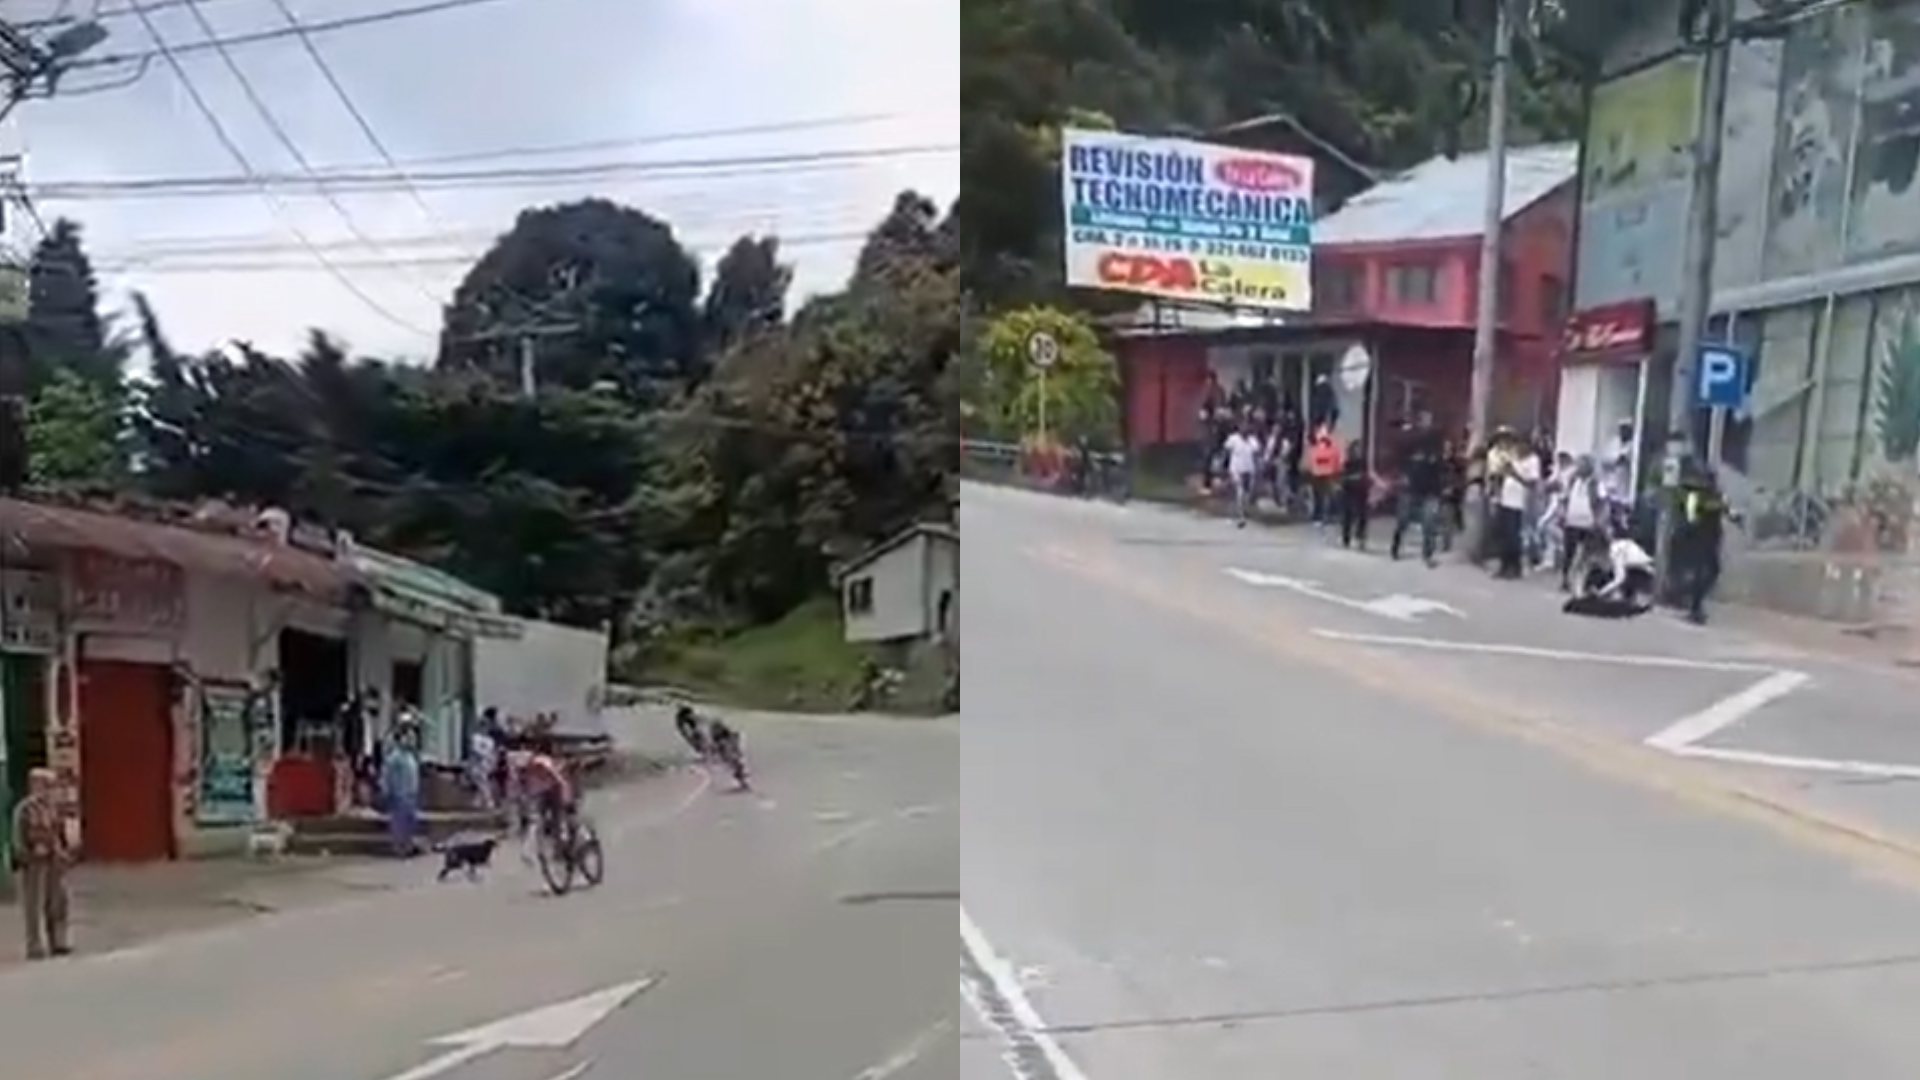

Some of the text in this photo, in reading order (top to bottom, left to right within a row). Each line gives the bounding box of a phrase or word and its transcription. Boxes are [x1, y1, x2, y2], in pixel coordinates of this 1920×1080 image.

[1070, 145, 1204, 185] REVISIÓN
[1098, 250, 1197, 292] CDA
[1199, 259, 1233, 278] La
[1200, 277, 1287, 300] Calera
[1700, 351, 1736, 400] P
